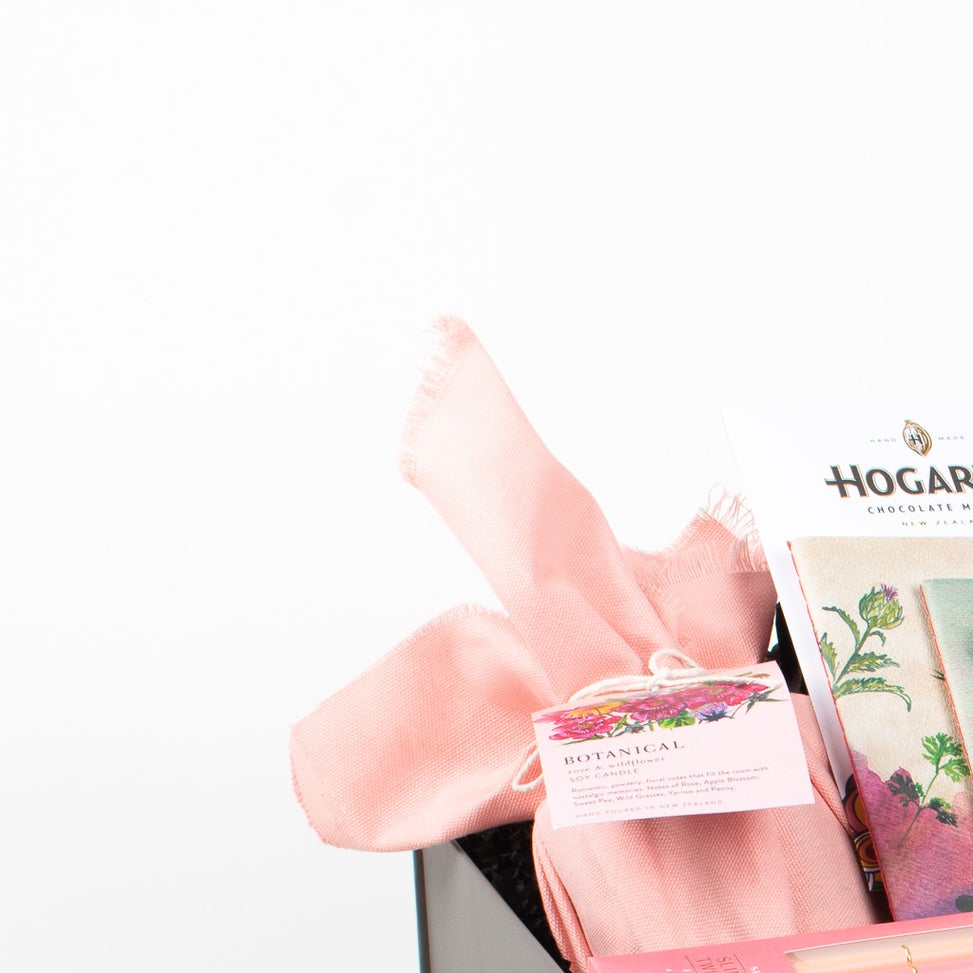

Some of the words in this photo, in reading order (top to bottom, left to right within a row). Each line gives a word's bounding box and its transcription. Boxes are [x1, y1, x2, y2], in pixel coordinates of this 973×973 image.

[867, 502, 953, 514] CHOCOLATE
[564, 740, 685, 765] BOTANICAL
[608, 756, 665, 769] wildflower
[569, 775, 590, 783] SOY
[594, 768, 639, 779] CANDLE
